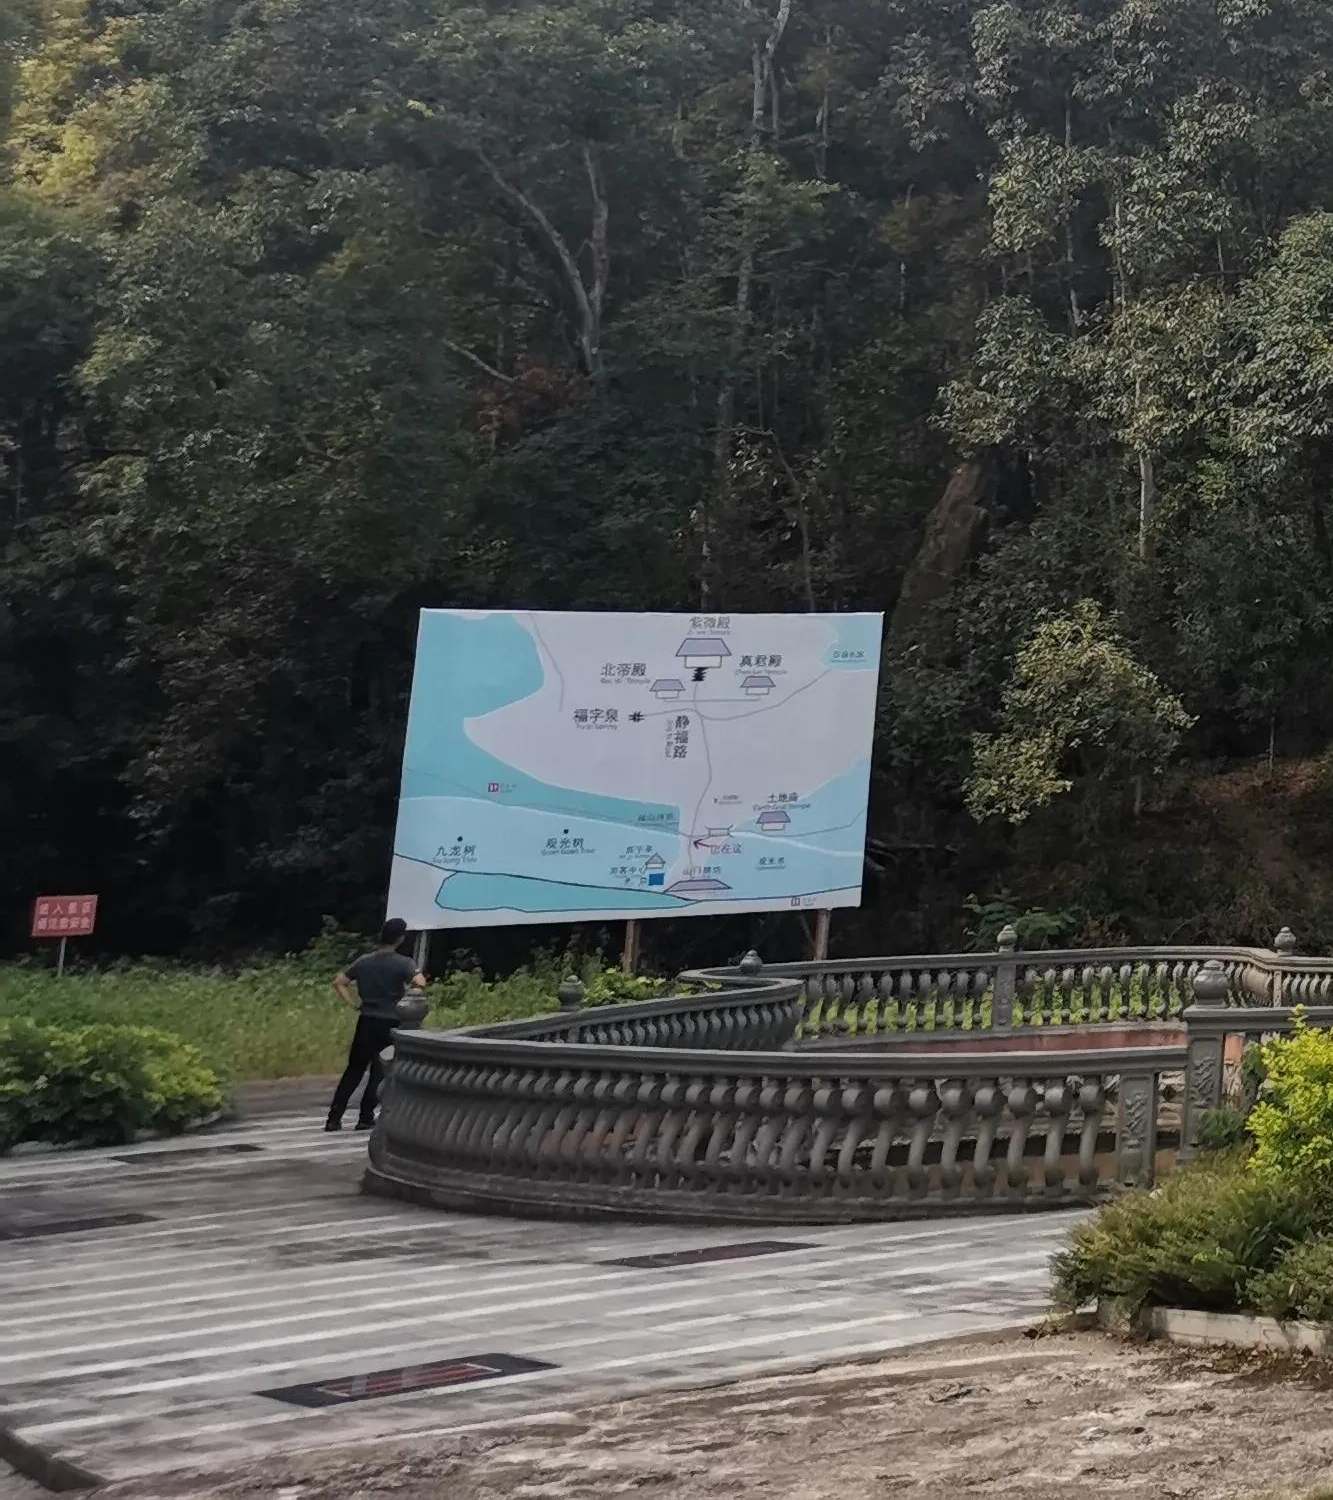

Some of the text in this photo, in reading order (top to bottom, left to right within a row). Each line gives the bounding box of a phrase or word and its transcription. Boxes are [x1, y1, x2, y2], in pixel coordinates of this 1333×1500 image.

[600, 662, 647, 678] 北帝殿
[572, 707, 619, 723] 福字泉
[672, 715, 690, 759] 静福路
